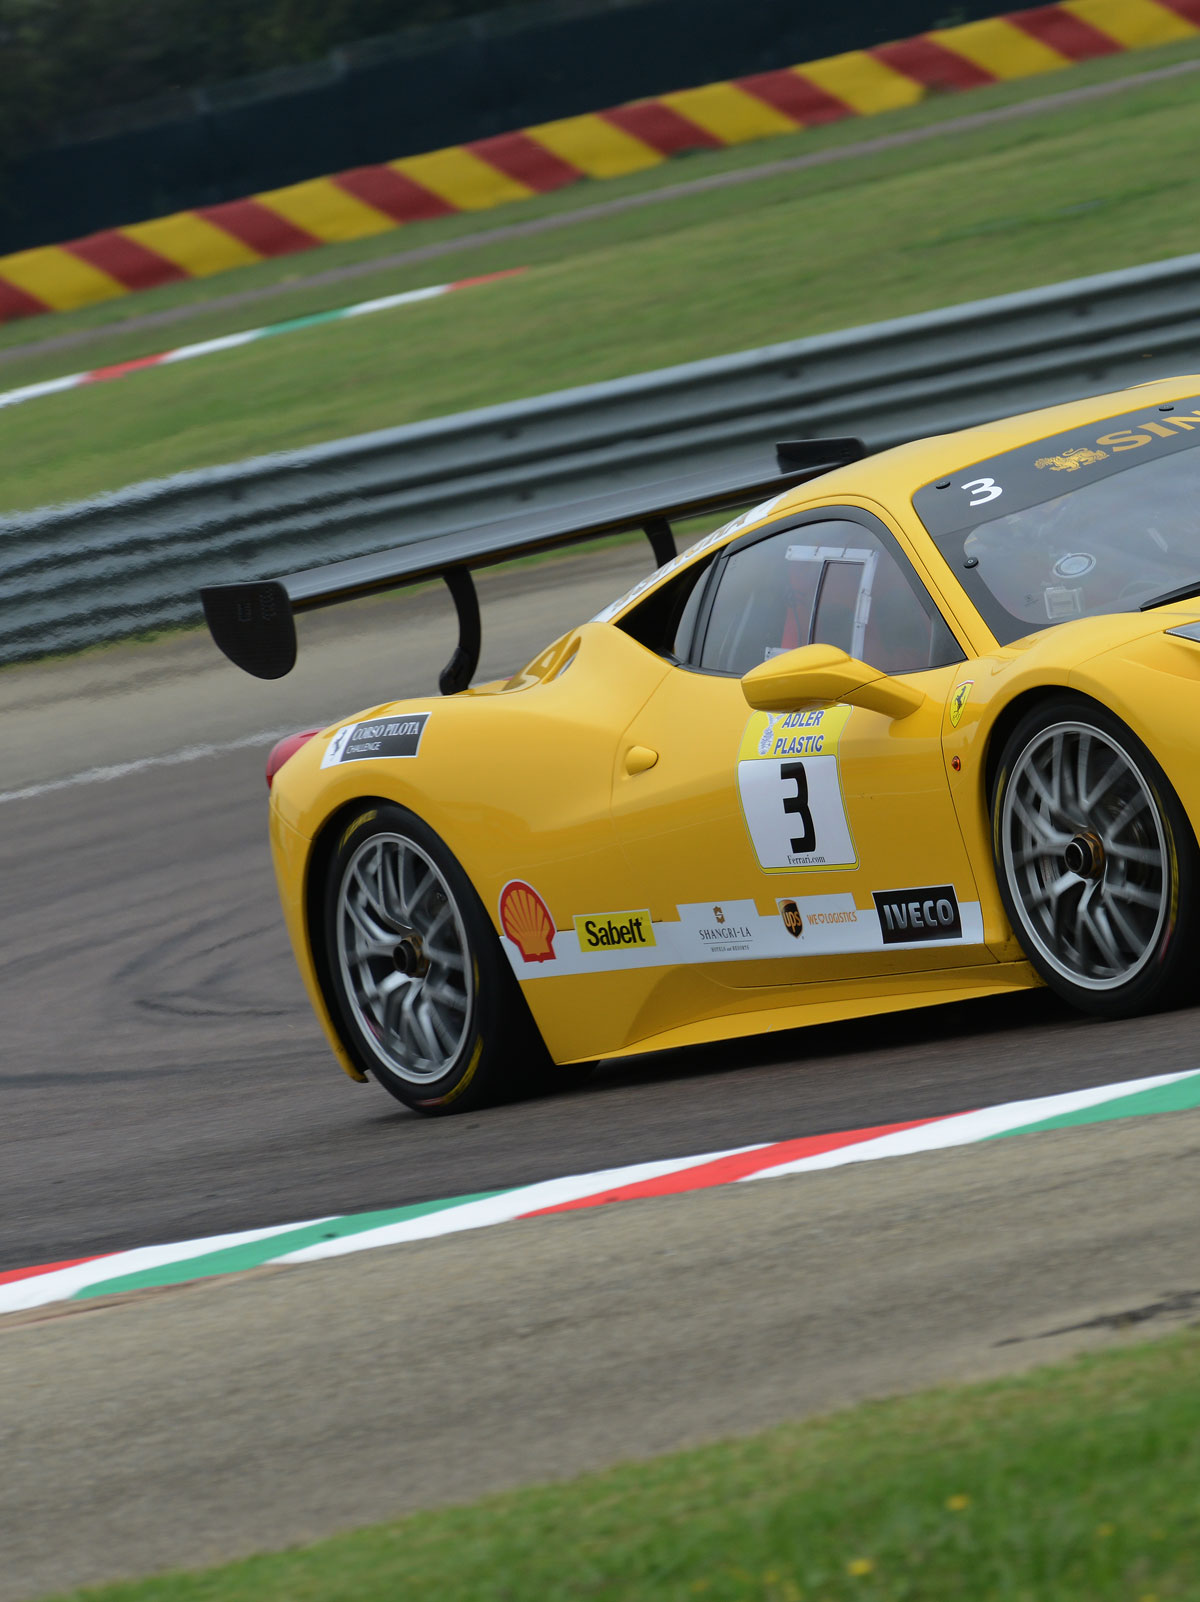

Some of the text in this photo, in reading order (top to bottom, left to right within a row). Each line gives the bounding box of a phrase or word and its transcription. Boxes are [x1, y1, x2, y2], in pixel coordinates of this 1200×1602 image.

[961, 477, 1003, 506] 3
[781, 710, 825, 729] ADLER
[352, 721, 420, 741] CORSO PILOTA
[346, 741, 381, 755] CHALLENGE
[773, 735, 825, 755] PLASTIC
[780, 761, 816, 854] 3
[786, 853, 826, 865] Ferrari.com
[782, 911, 802, 933] ups
[806, 911, 858, 926] WE LOGISTICS
[883, 899, 955, 931] IVECO
[584, 918, 647, 947] Sabelt
[698, 926, 752, 940] SHANGRI-LA
